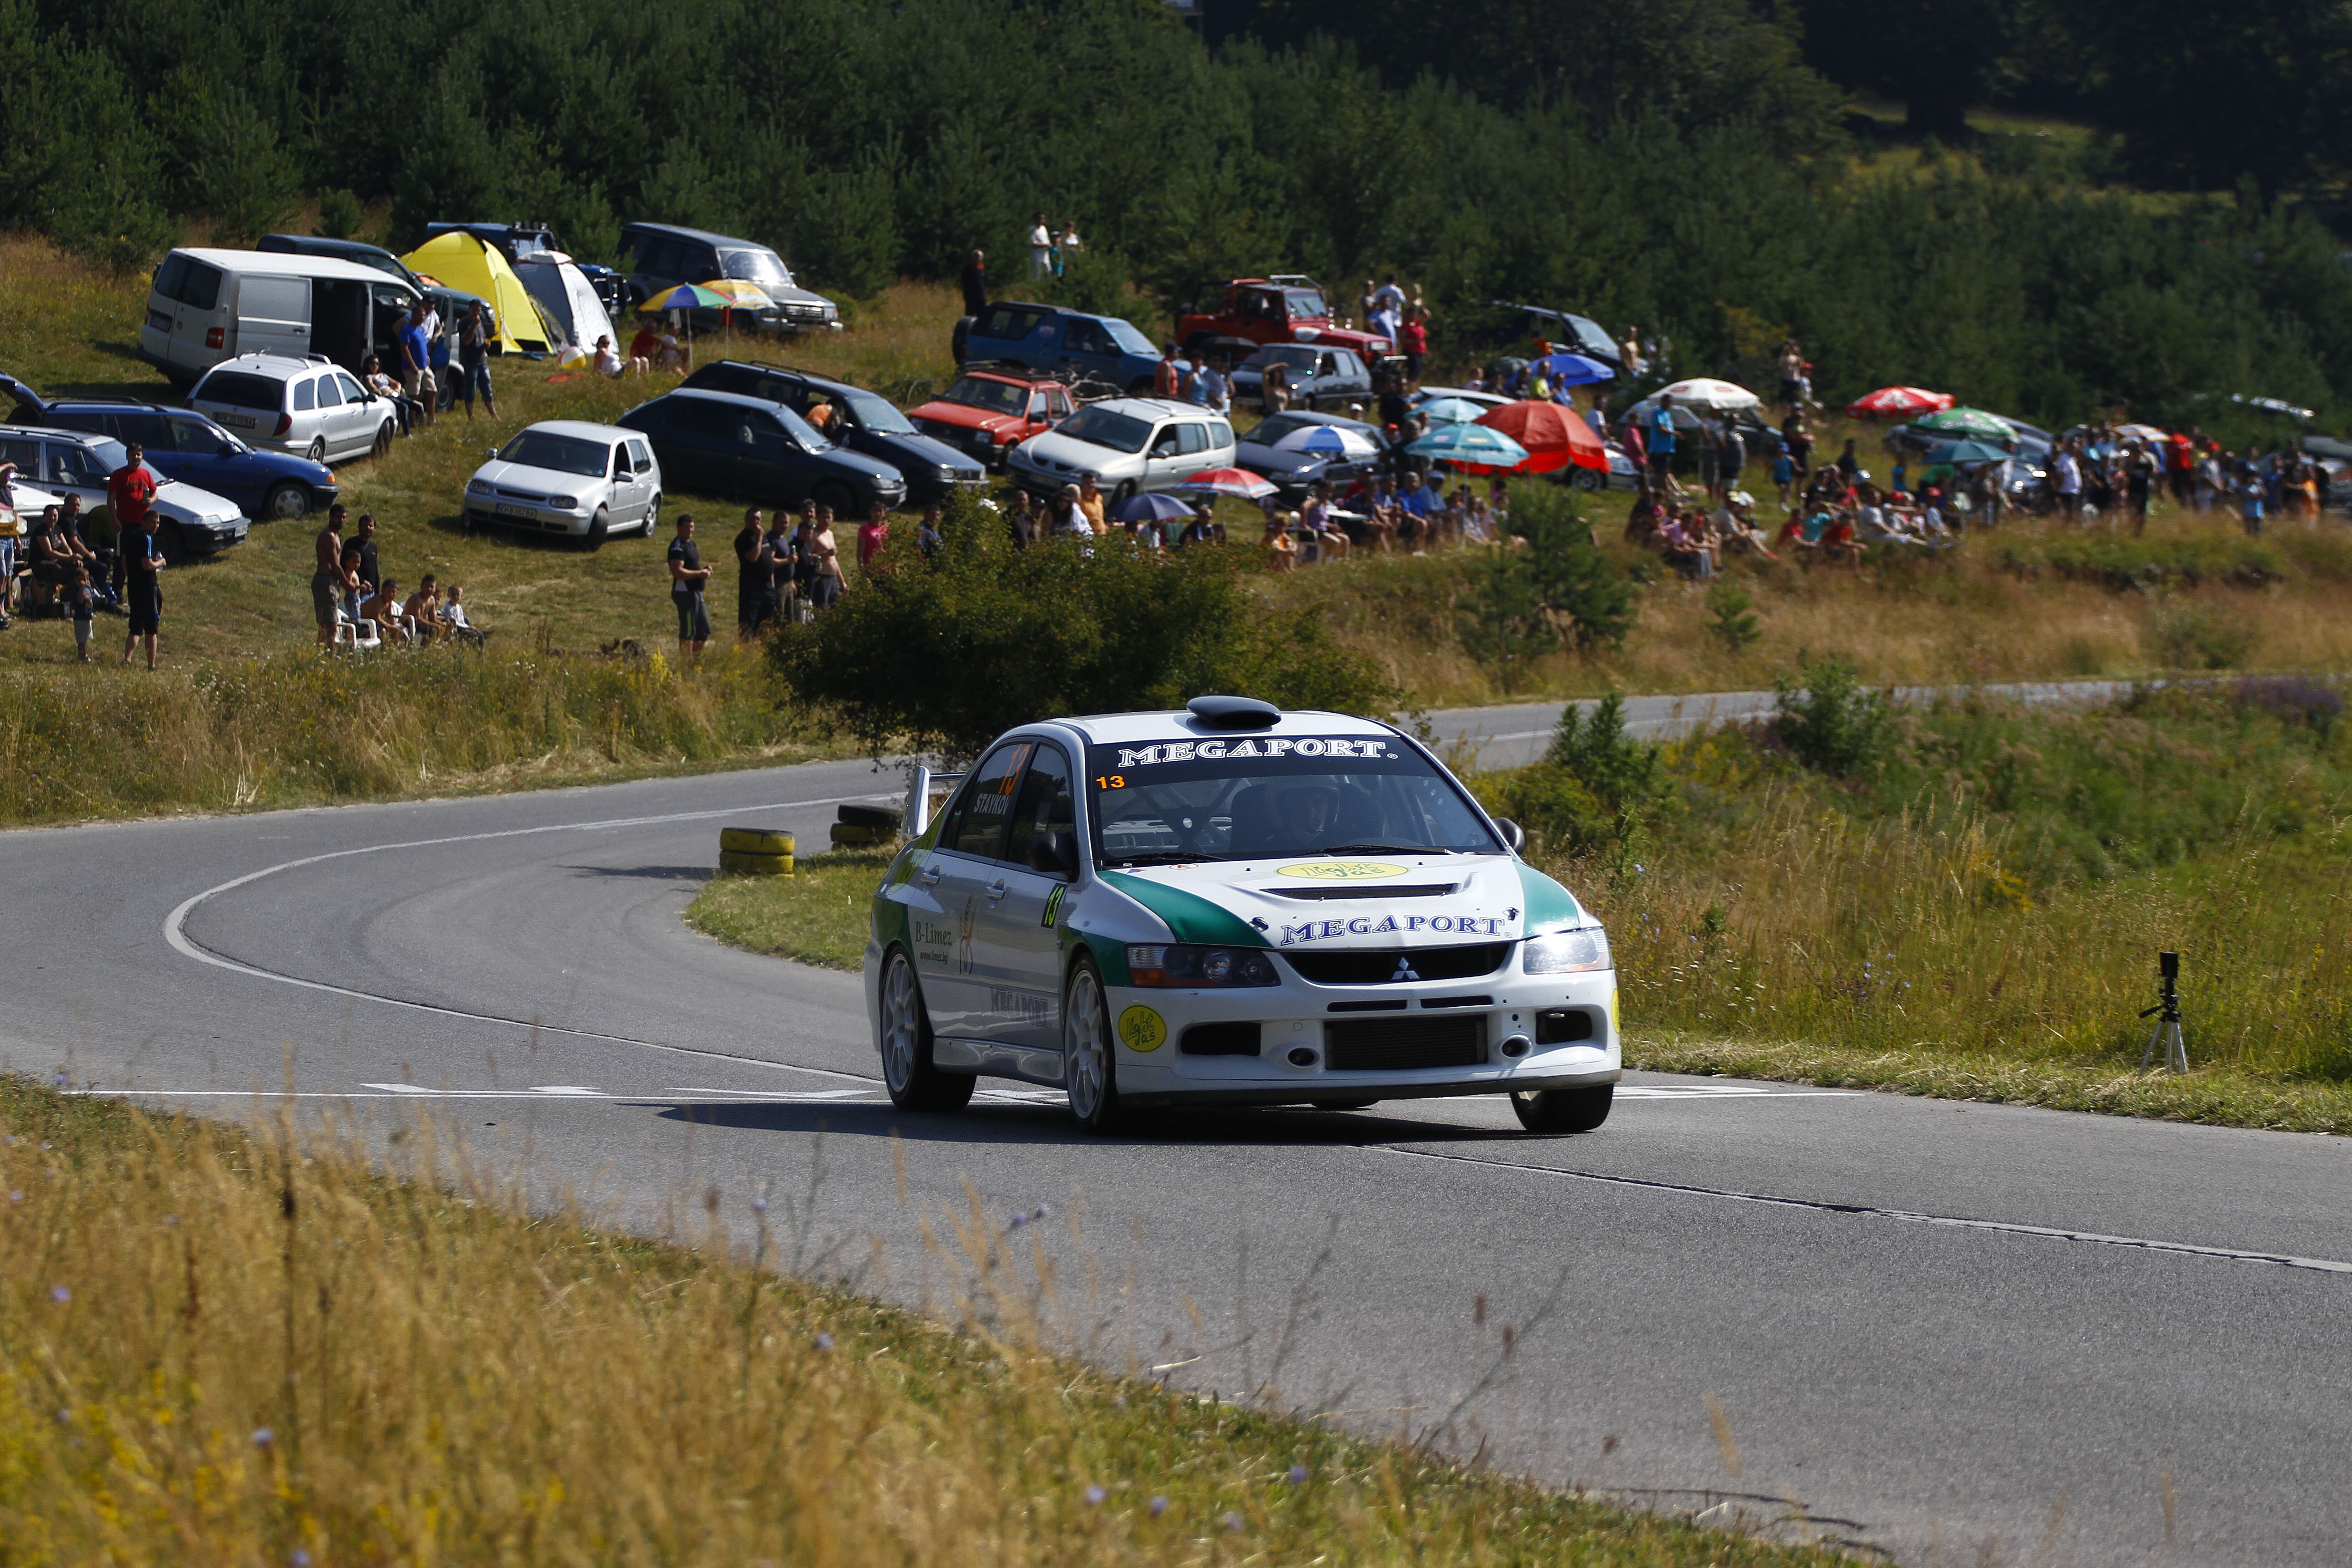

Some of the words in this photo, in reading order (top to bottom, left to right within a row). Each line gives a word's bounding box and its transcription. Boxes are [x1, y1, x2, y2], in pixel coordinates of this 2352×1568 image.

[1117, 739, 1387, 768] MEGAPORT
[998, 743, 1032, 796] 13
[1096, 775, 1126, 789] 13
[974, 793, 1010, 815] STAYKOV
[1044, 886, 1064, 926] 13
[915, 921, 952, 947] B-Limez
[1280, 915, 1505, 946] MEGAPORT
[920, 950, 948, 965] www.limez.bg
